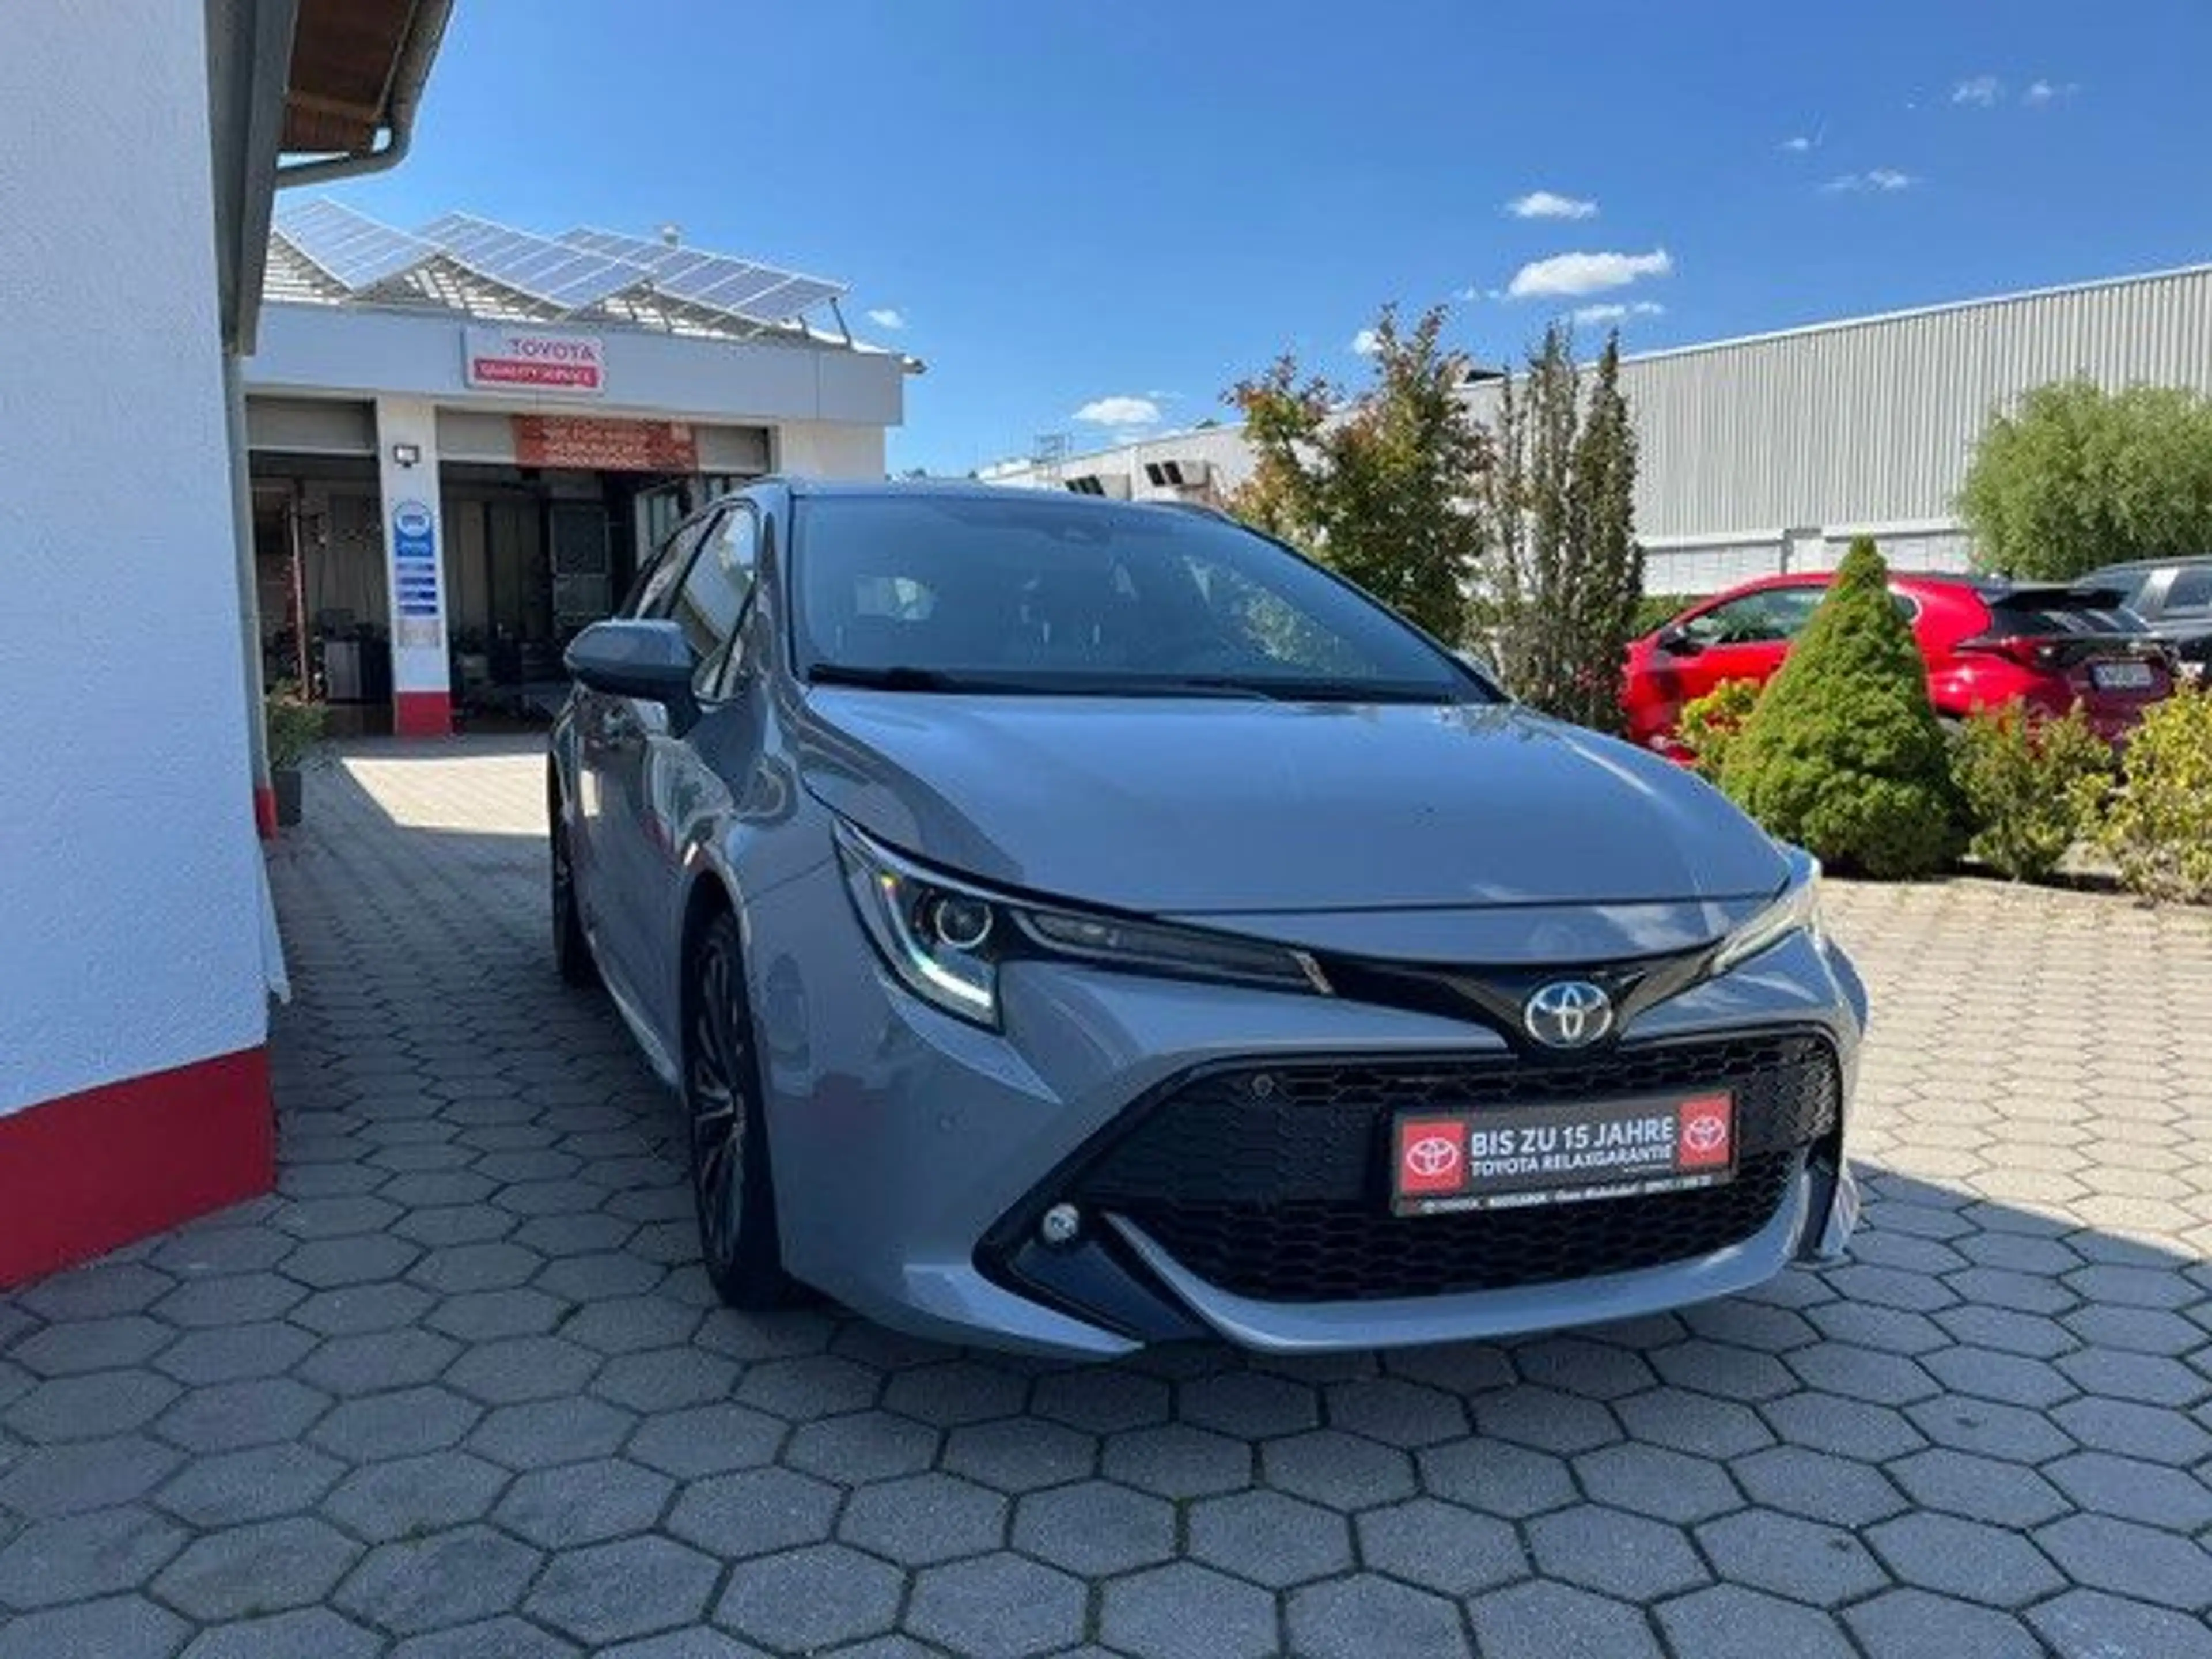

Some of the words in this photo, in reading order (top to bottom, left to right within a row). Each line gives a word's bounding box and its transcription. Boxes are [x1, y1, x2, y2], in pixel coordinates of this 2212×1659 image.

[509, 338, 596, 359] TOYOTA
[1472, 1130, 1515, 1157] BIS
[1520, 1127, 1556, 1153] ZU
[1563, 1126, 1588, 1150] 15
[1593, 1116, 1674, 1148] JAHRE
[1469, 1154, 1539, 1177] TOYOTA
